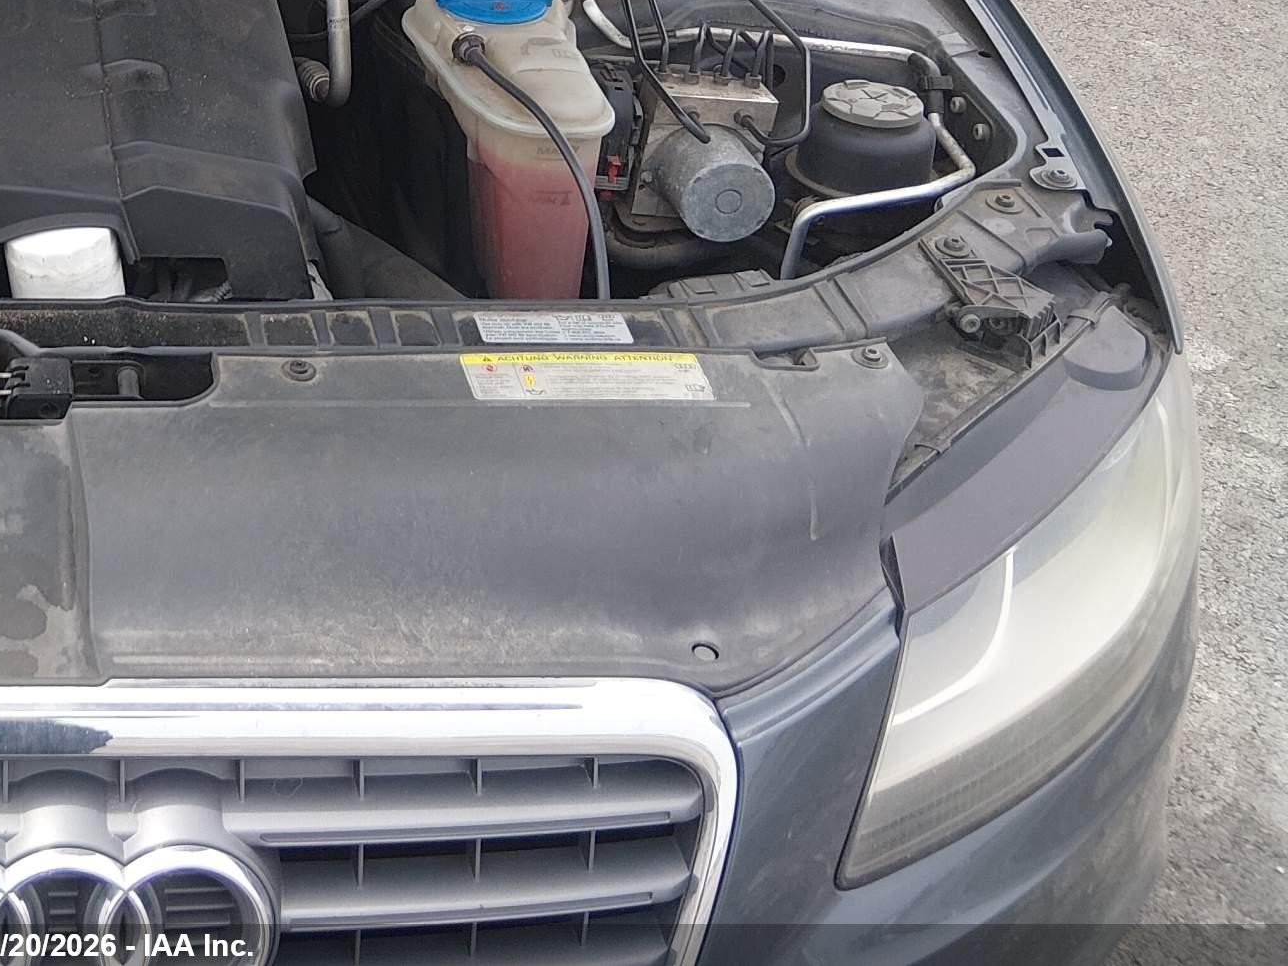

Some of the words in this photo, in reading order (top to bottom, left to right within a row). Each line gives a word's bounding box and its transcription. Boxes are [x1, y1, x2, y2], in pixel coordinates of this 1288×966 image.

[497, 354, 550, 362] ACHTUNG
[552, 353, 608, 362] WARNING
[613, 353, 673, 362] ATTENTION
